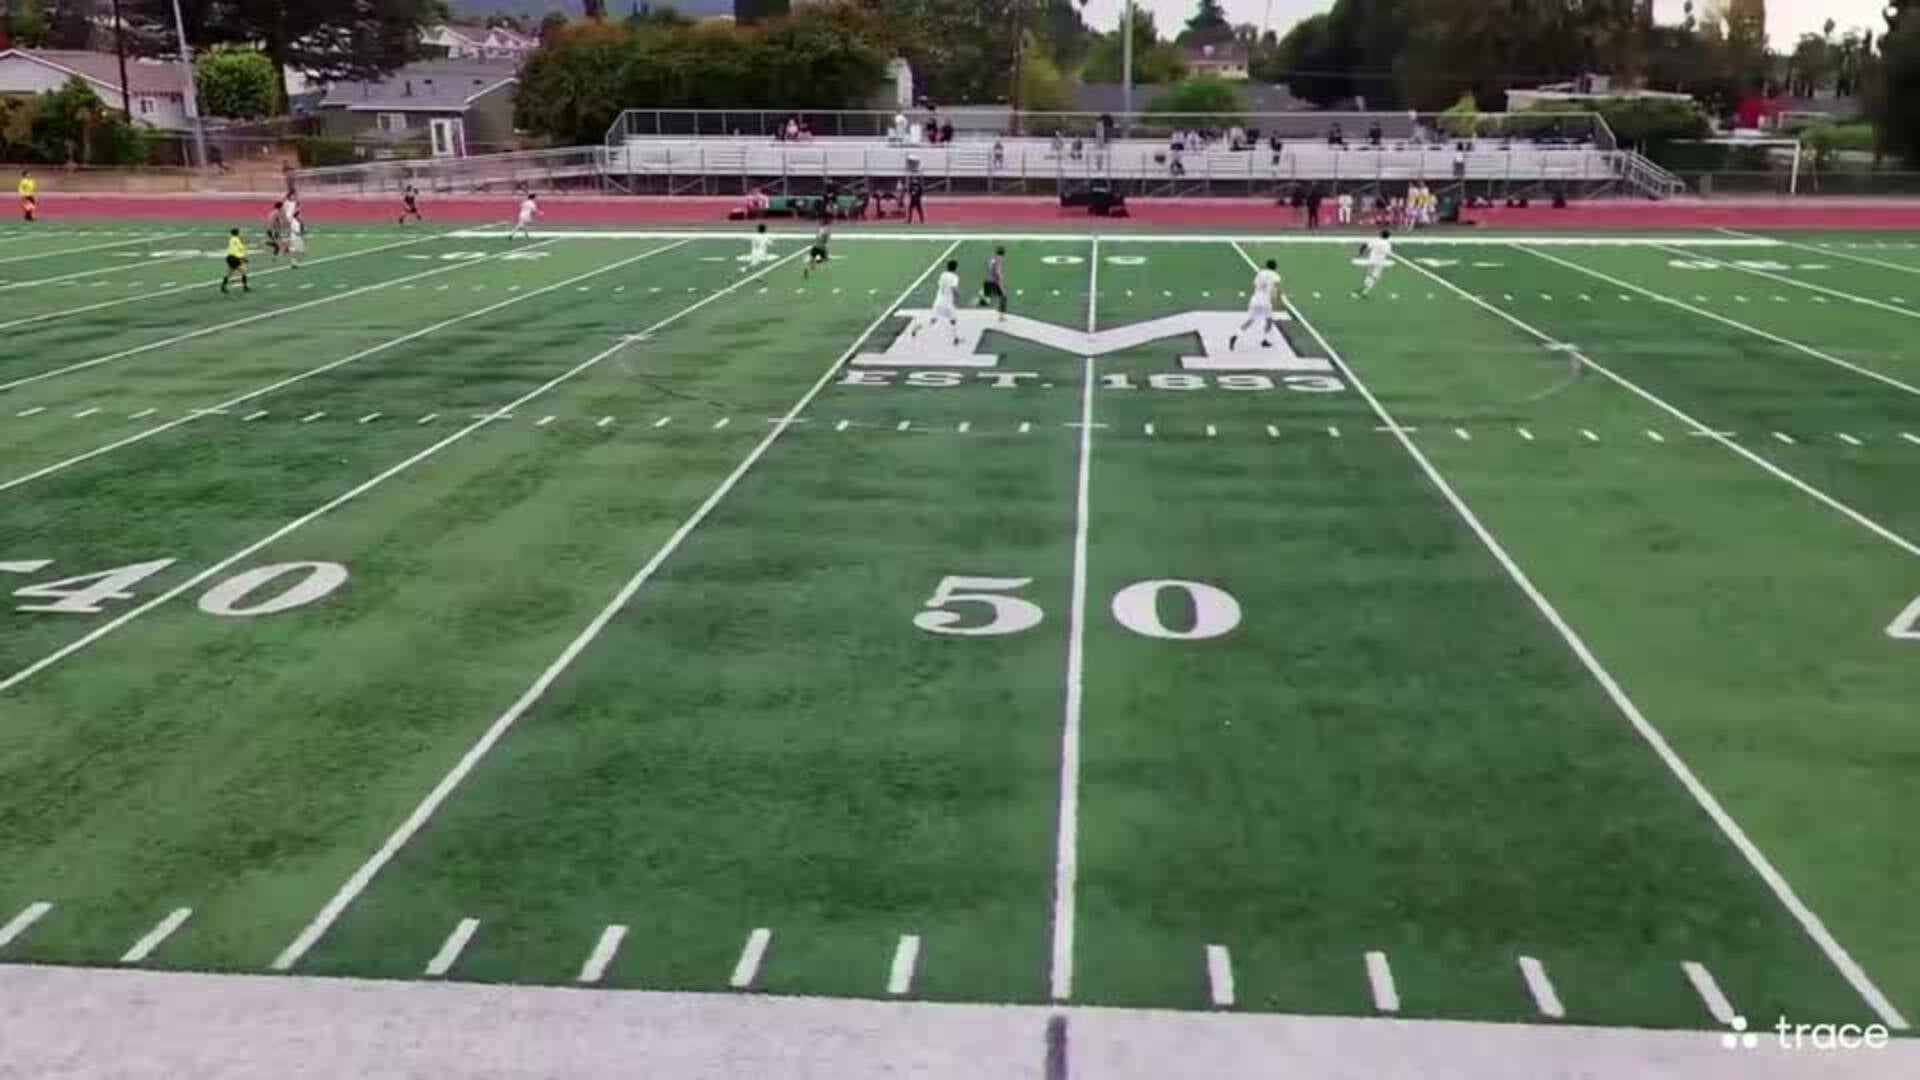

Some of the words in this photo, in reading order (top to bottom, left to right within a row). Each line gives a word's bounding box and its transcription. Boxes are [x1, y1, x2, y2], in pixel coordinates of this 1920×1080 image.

[849, 308, 1334, 370] M
[836, 371, 1053, 388] EST.
[1103, 373, 1345, 391] 1893
[11, 558, 349, 615] 40
[912, 576, 1242, 639] 50
